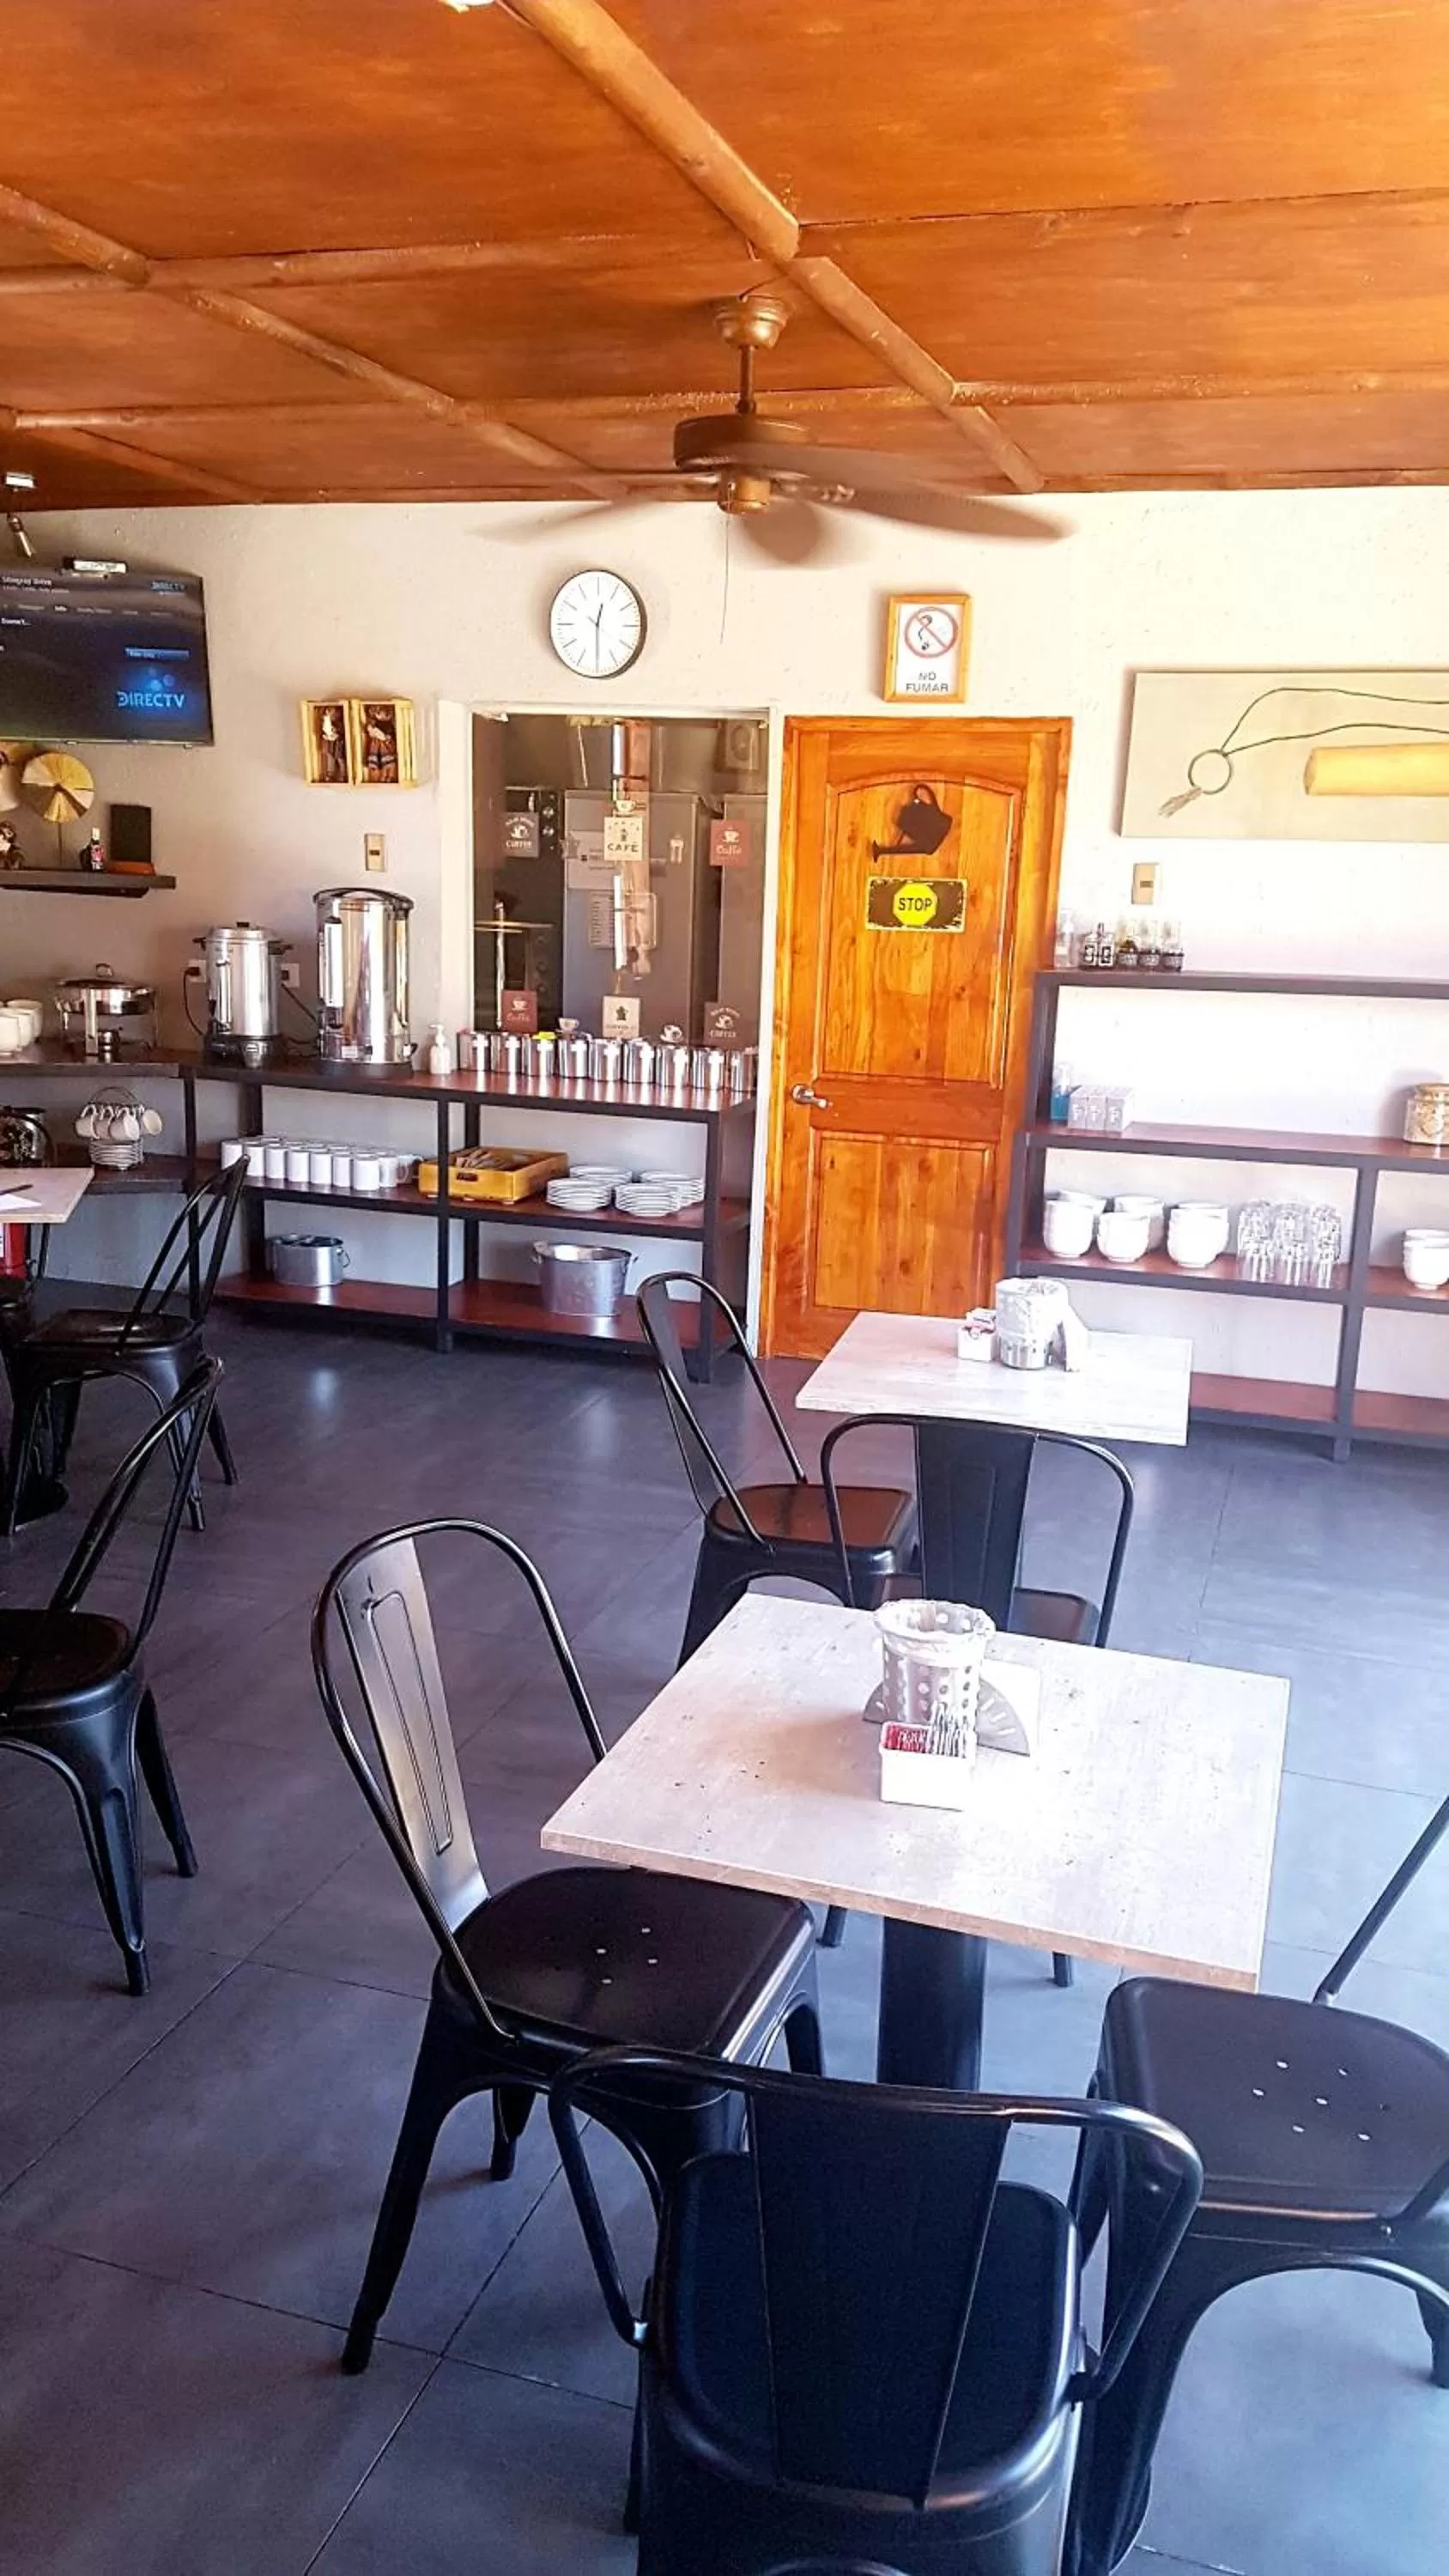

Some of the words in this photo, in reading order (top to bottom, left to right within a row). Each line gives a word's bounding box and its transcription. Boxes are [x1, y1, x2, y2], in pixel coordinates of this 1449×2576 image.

[919, 671, 937, 681] NO
[906, 683, 949, 692] FUMAR
[117, 691, 185, 708] DIRECTV
[898, 897, 932, 911] STOP
